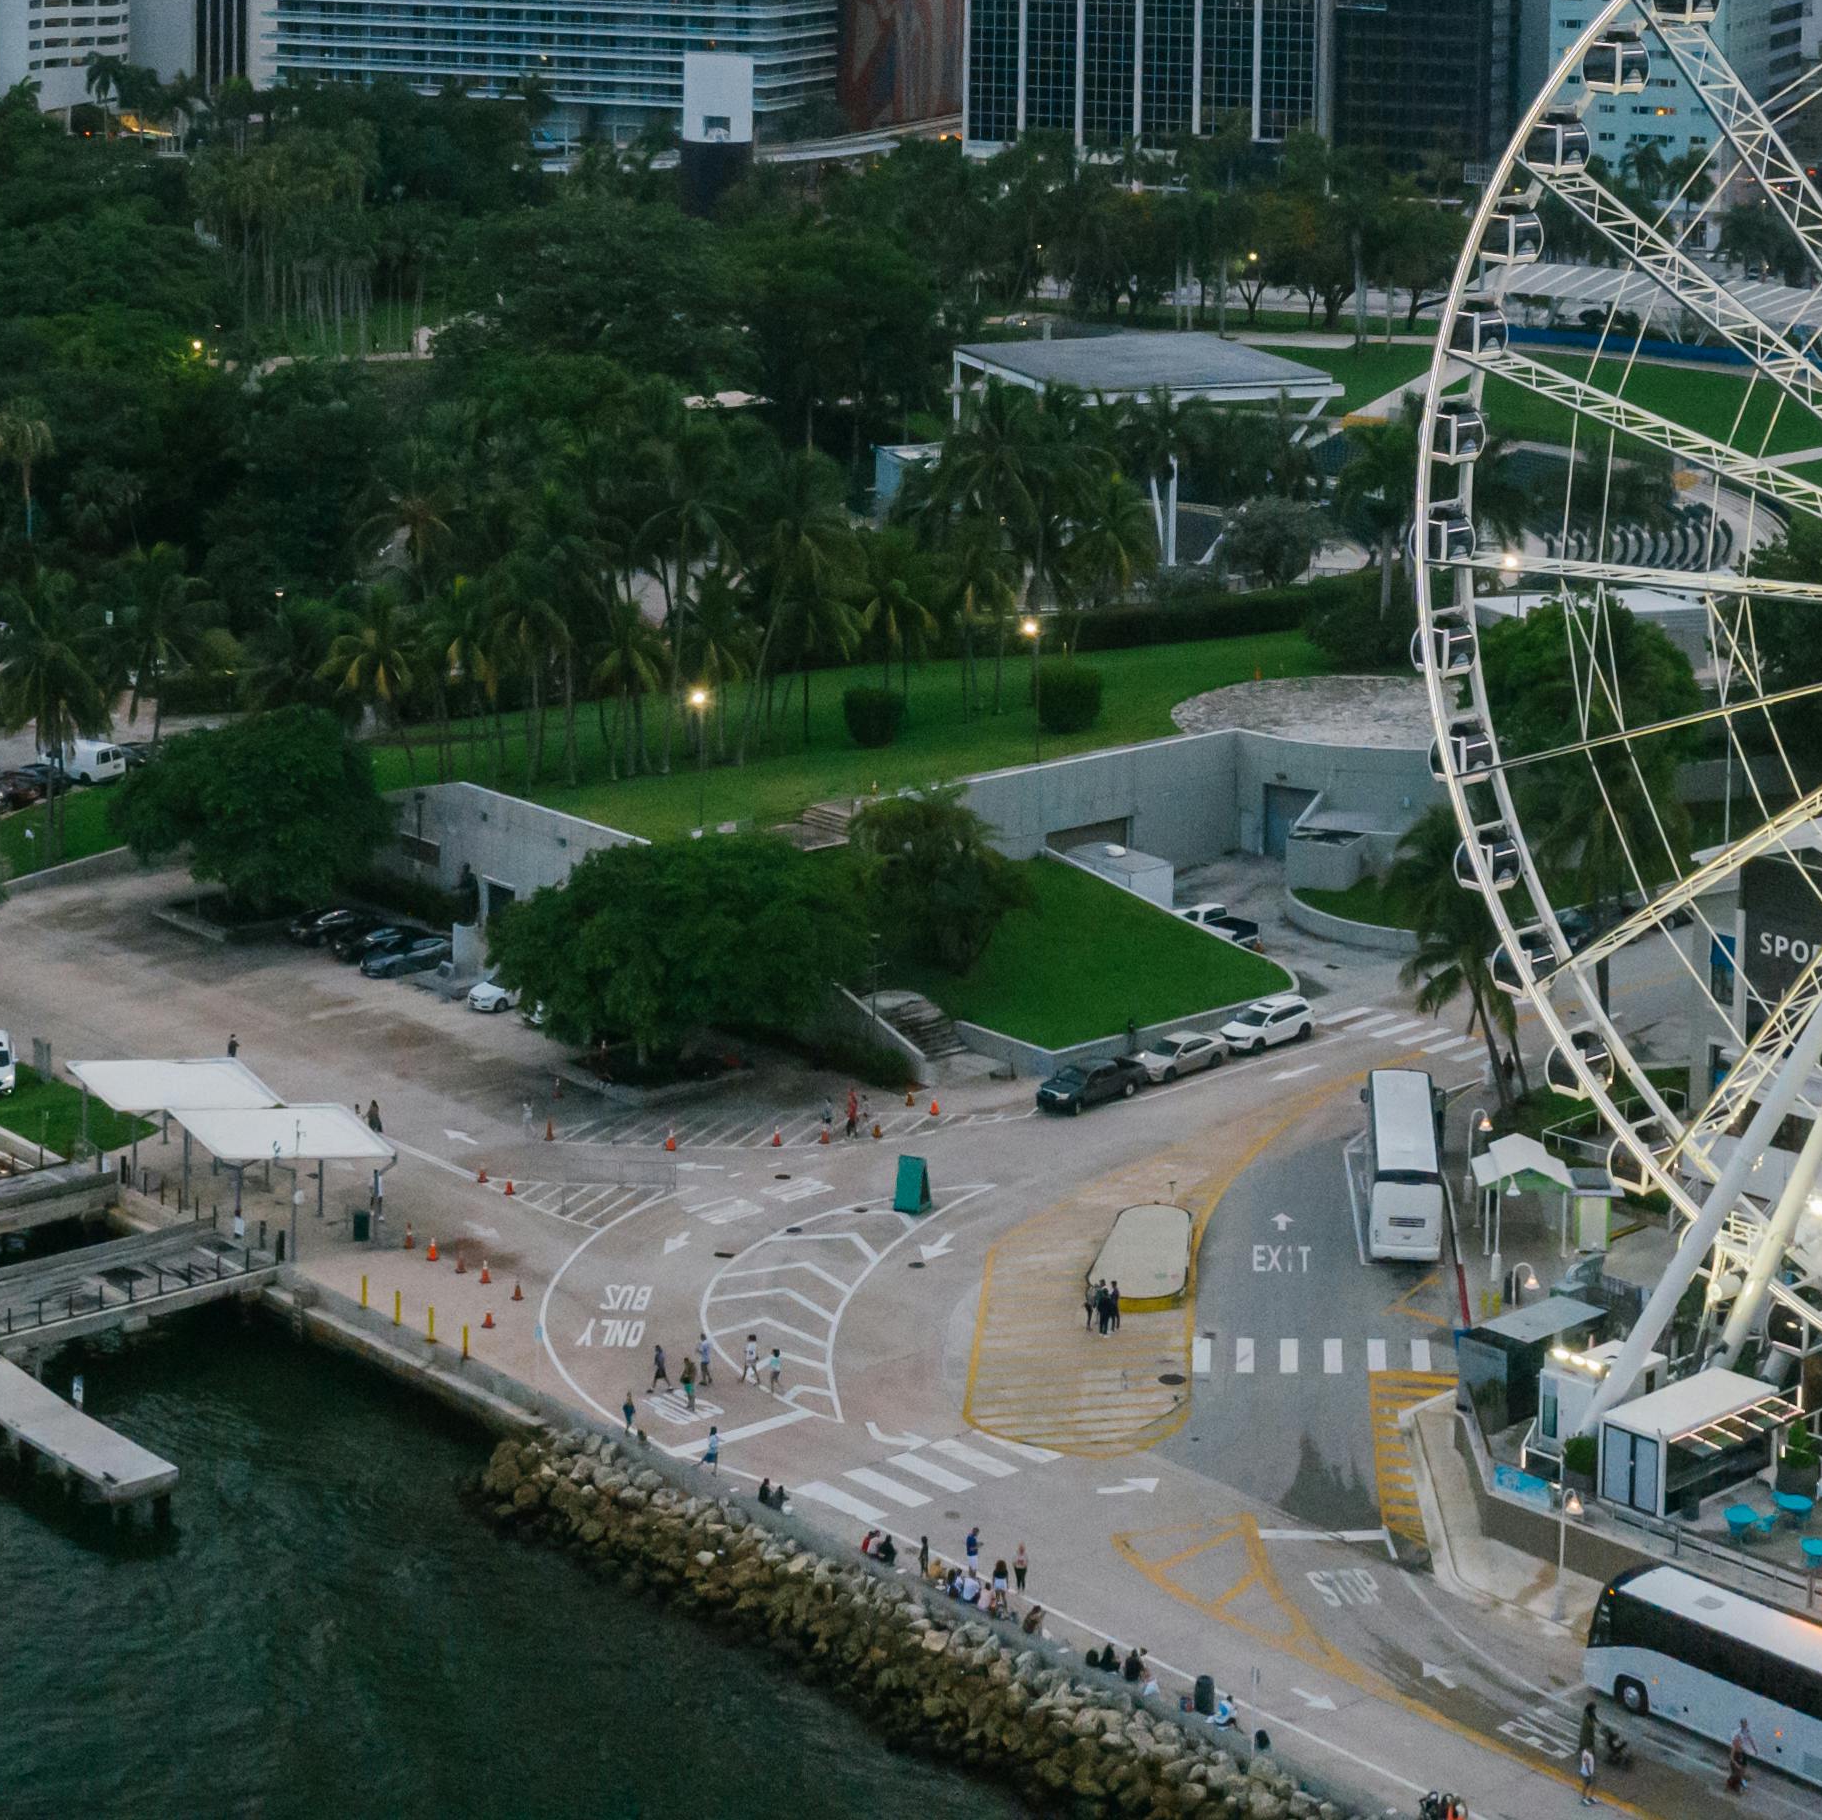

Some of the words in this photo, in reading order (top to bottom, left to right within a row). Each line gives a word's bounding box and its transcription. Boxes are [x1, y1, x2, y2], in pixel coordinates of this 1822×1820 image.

[1252, 1244, 1312, 1273] EXIT
[599, 1284, 654, 1311] BUS
[575, 1318, 646, 1348] ONLY
[1304, 1568, 1382, 1607] STOP
